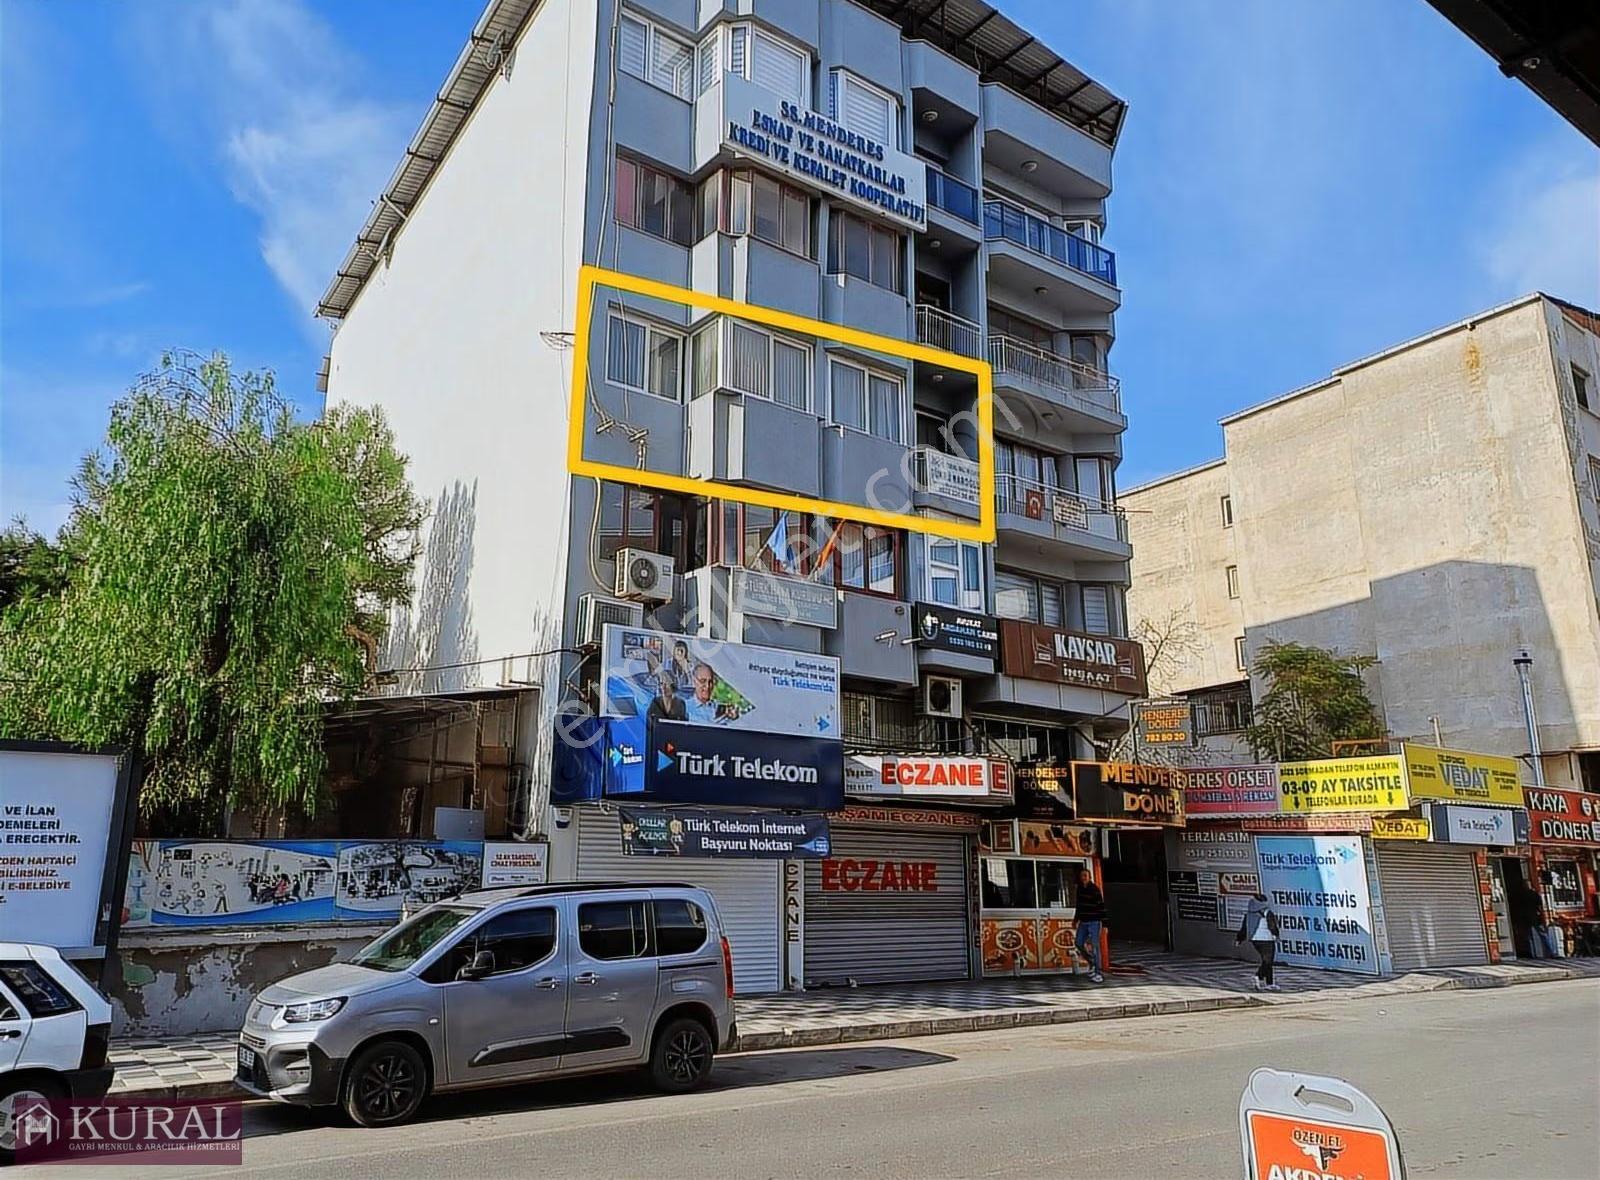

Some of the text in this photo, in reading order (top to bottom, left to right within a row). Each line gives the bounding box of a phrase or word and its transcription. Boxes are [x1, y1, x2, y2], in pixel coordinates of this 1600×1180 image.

[753, 109, 905, 194] ESNAF VE SANATKARLAR
[729, 121, 925, 224] KREDİ VE KEFALET KOOPERATİFİ
[1054, 633, 1117, 666] KAYSAR
[772, 676, 789, 686] Türk
[676, 751, 818, 784] Türk Telekom
[881, 763, 984, 786] ECZANE
[993, 764, 1007, 789] E
[1295, 765, 1334, 775] SORMADAN
[1335, 763, 1365, 773] TELEFON
[1366, 761, 1398, 771] ALMAYIN
[1439, 763, 1489, 790] VEDAT
[1227, 769, 1273, 787] OFSET
[1282, 773, 1401, 795] 03-09 AY TAKSİTLE
[5, 804, 55, 816] VE İLAN
[1123, 788, 1181, 815] DÖNER
[1306, 796, 1348, 808] TELEFONLAR
[1529, 792, 1569, 813] KAYA
[684, 817, 806, 835] Türk Telekom İnternet
[1378, 822, 1422, 834] VEDAT
[1542, 815, 1592, 841] DÖNER
[6, 833, 81, 844] ERECEKTİR.
[701, 837, 793, 853] Başvuru Noktası
[0, 856, 76, 867] DEN HAFTAİÇİ
[1259, 852, 1285, 864] Türk
[1287, 853, 1336, 865] Telekom
[8, 881, 71, 890] E-BELEDİYE
[821, 860, 938, 892] ECZANE
[786, 864, 799, 942] CZANE
[1272, 888, 1357, 908] TEKNİK SERVİS
[1314, 918, 1323, 931] &
[1324, 915, 1359, 935] YASİR
[1327, 943, 1366, 964] SATIŞI
